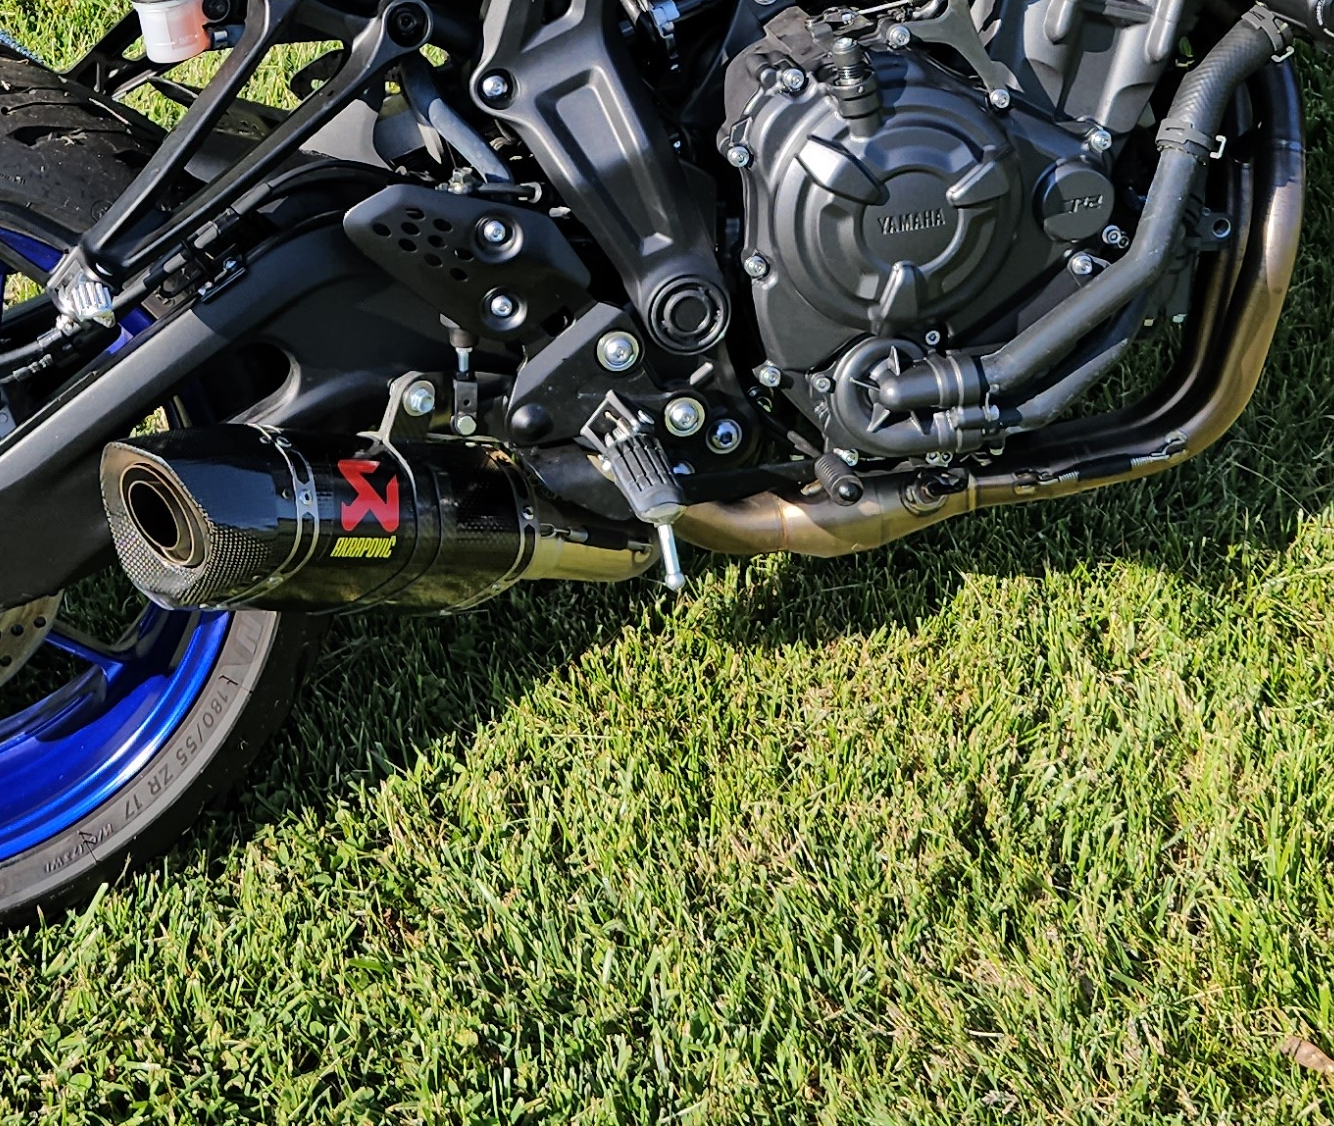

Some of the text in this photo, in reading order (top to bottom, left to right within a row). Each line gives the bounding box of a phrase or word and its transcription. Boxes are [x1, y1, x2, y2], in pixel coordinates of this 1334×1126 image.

[877, 208, 946, 235] YAMAHA
[175, 690, 229, 767] 180/55
[147, 764, 174, 795] ZR
[125, 793, 144, 820] 17
